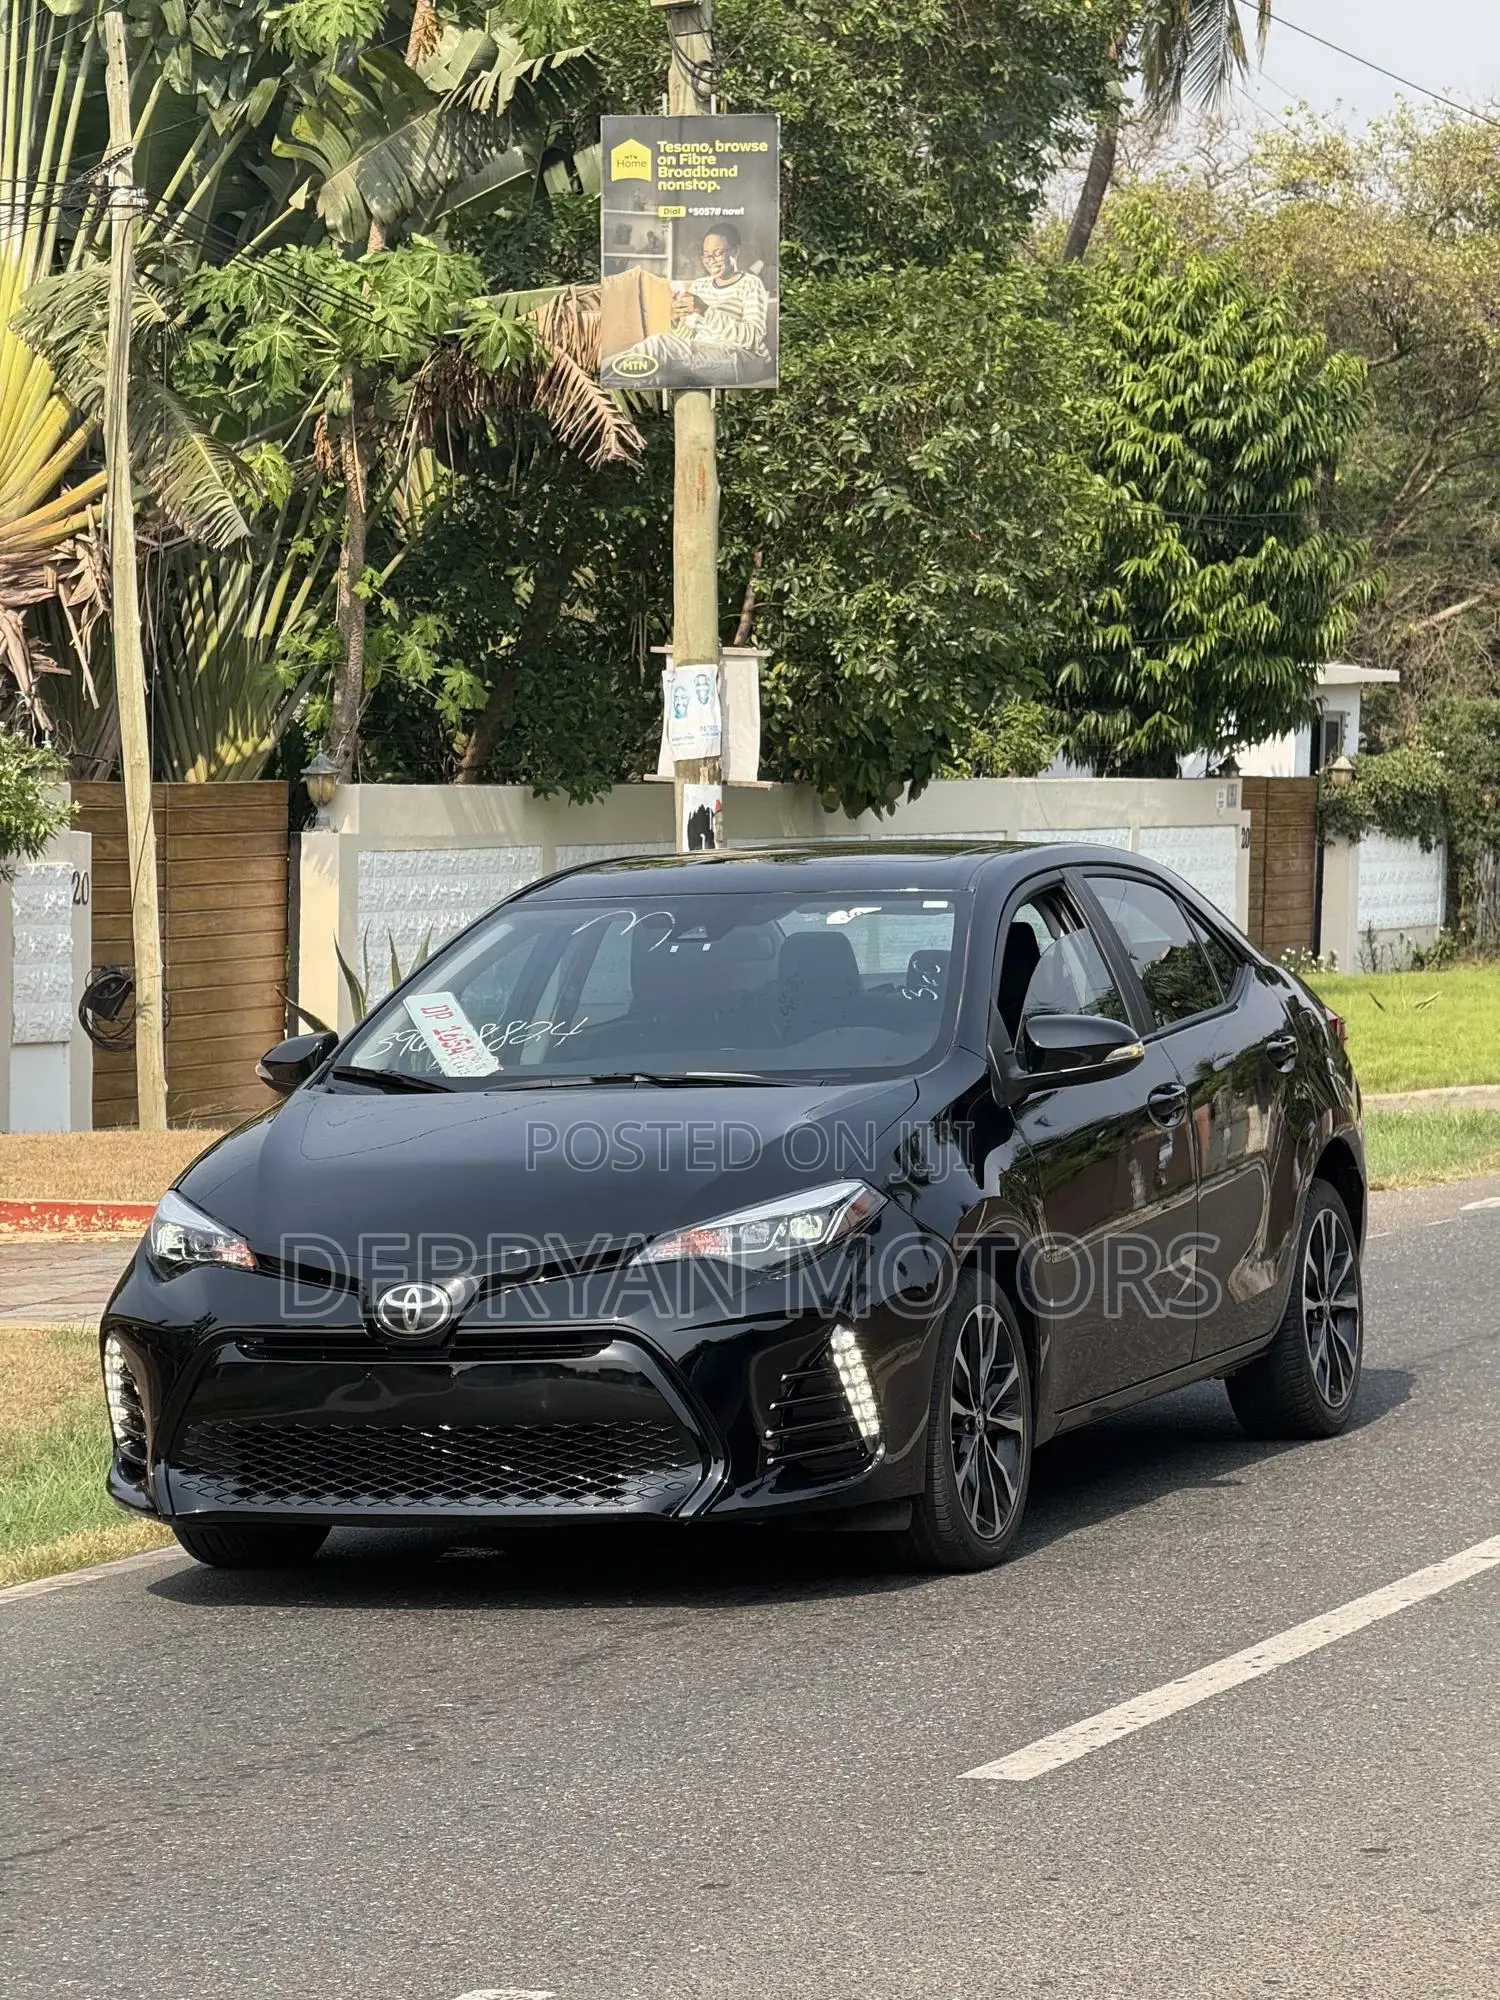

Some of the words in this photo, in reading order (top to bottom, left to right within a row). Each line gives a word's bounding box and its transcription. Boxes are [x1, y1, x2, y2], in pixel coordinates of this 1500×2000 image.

[657, 141, 713, 154] Tesano,
[715, 140, 768, 152] browse
[616, 160, 647, 168] Home
[657, 156, 676, 165] on
[679, 153, 717, 165] Fibre
[657, 165, 738, 178] Broadband
[657, 179, 721, 192] nonstop.
[623, 360, 648, 371] MTN
[1241, 826, 1250, 849] 20
[71, 870, 90, 906] 20
[420, 1004, 455, 1020] DP
